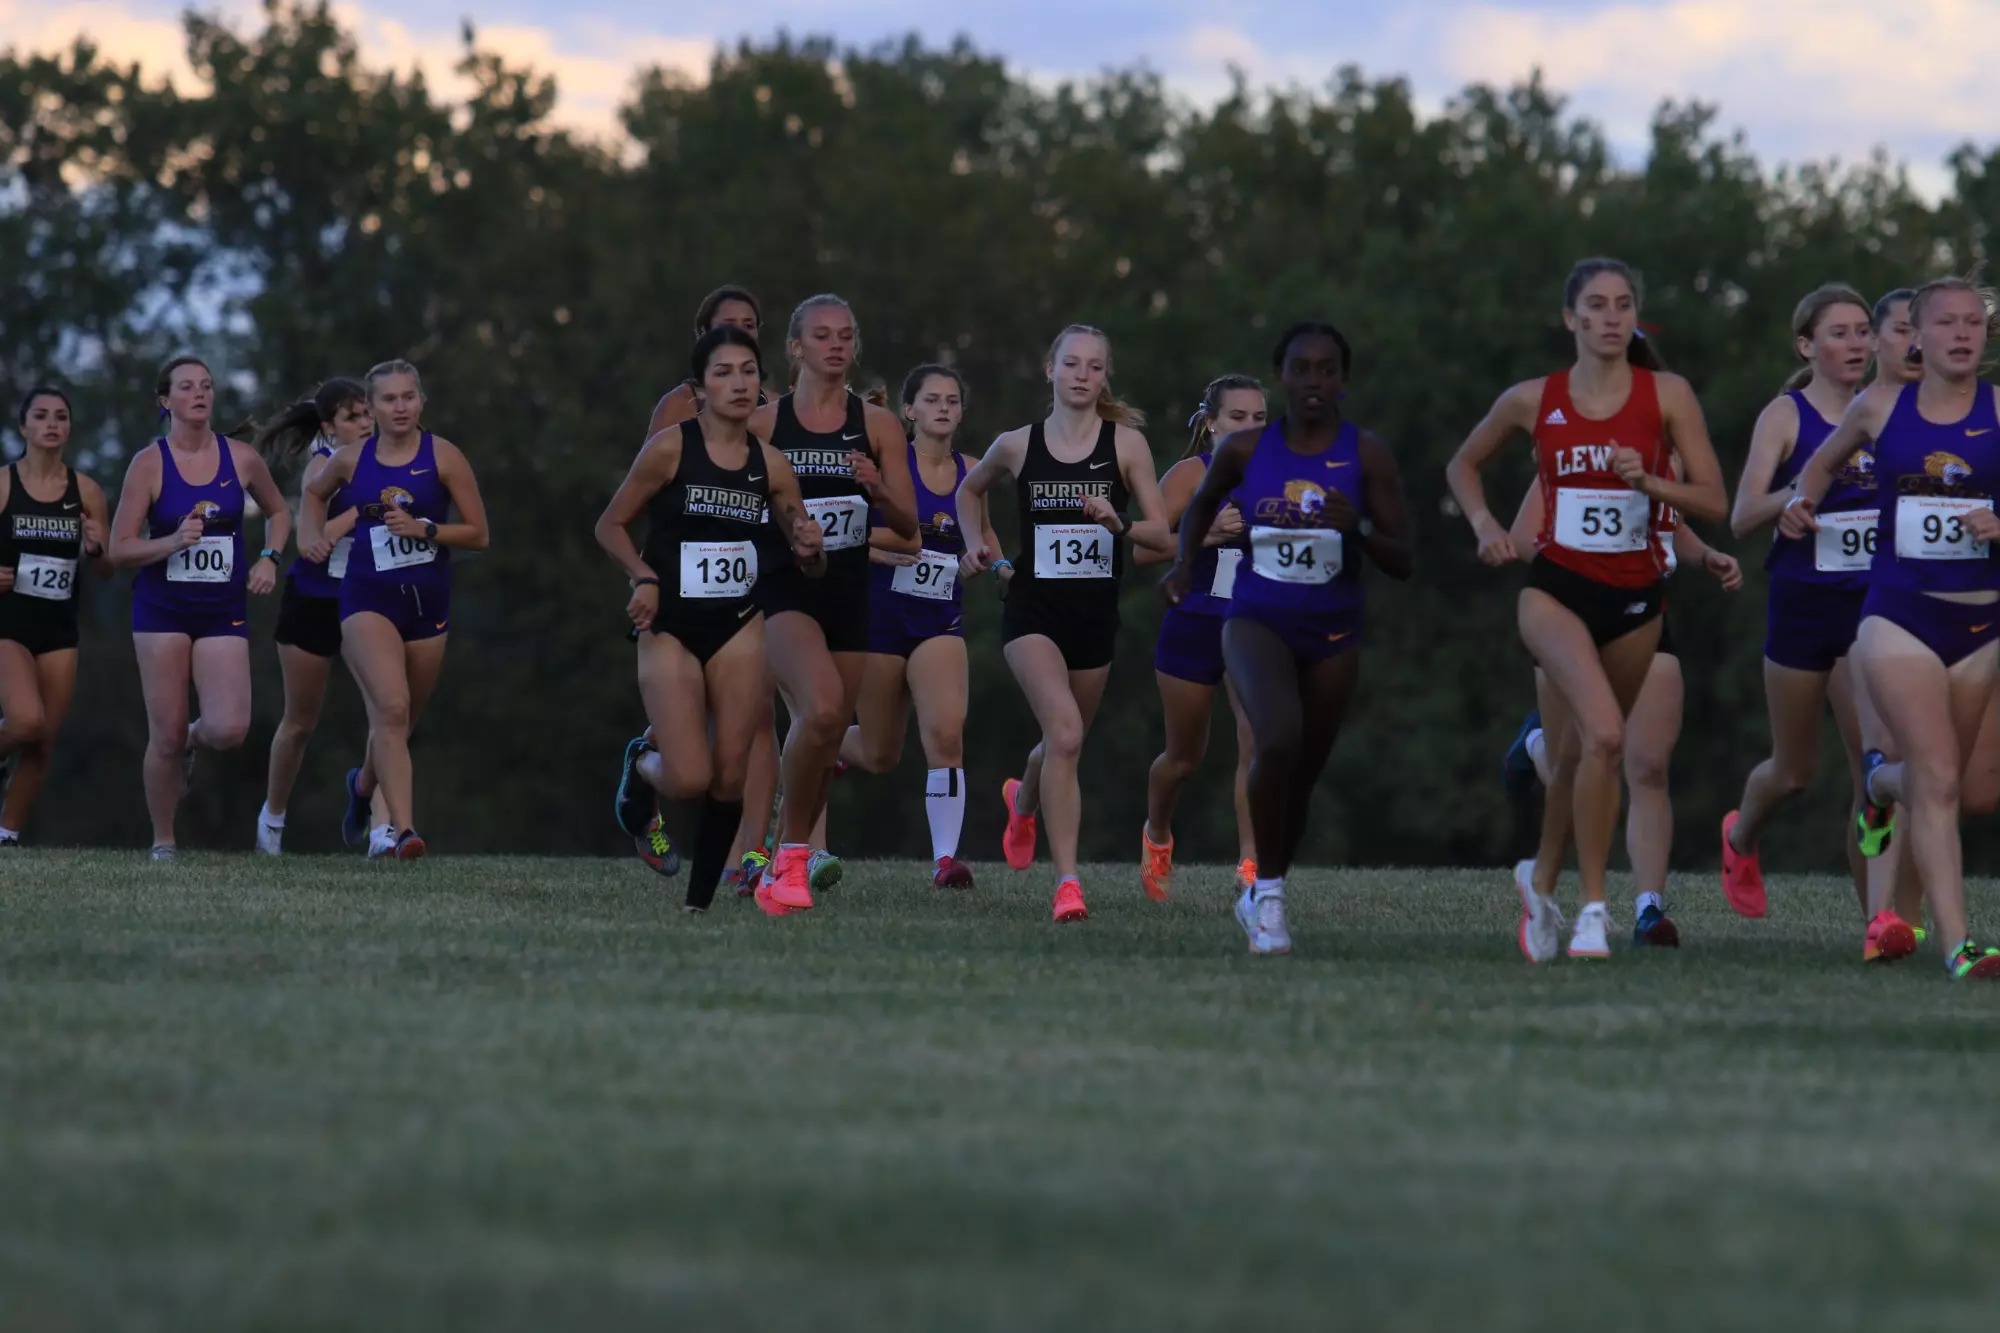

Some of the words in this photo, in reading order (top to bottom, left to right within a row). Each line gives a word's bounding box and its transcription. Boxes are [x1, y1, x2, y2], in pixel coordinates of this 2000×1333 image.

[783, 451, 851, 465] URDU
[1555, 444, 1613, 477] LEW
[792, 465, 852, 476] RTHWES
[689, 488, 760, 511] PURDUE
[1032, 483, 1108, 498] PURDUE
[688, 503, 759, 521] NORTHWEST
[1033, 498, 1085, 508] NORTHW
[16, 517, 79, 532] PURDUE
[1581, 507, 1622, 536] 53
[1923, 514, 1964, 544] 93
[16, 529, 77, 539] NORTHWEST
[180, 549, 224, 571] 100
[1049, 539, 1100, 565] 134
[1277, 541, 1316, 570] 94
[30, 566, 71, 590] 128
[696, 557, 747, 584] 130
[914, 562, 945, 586] 97
